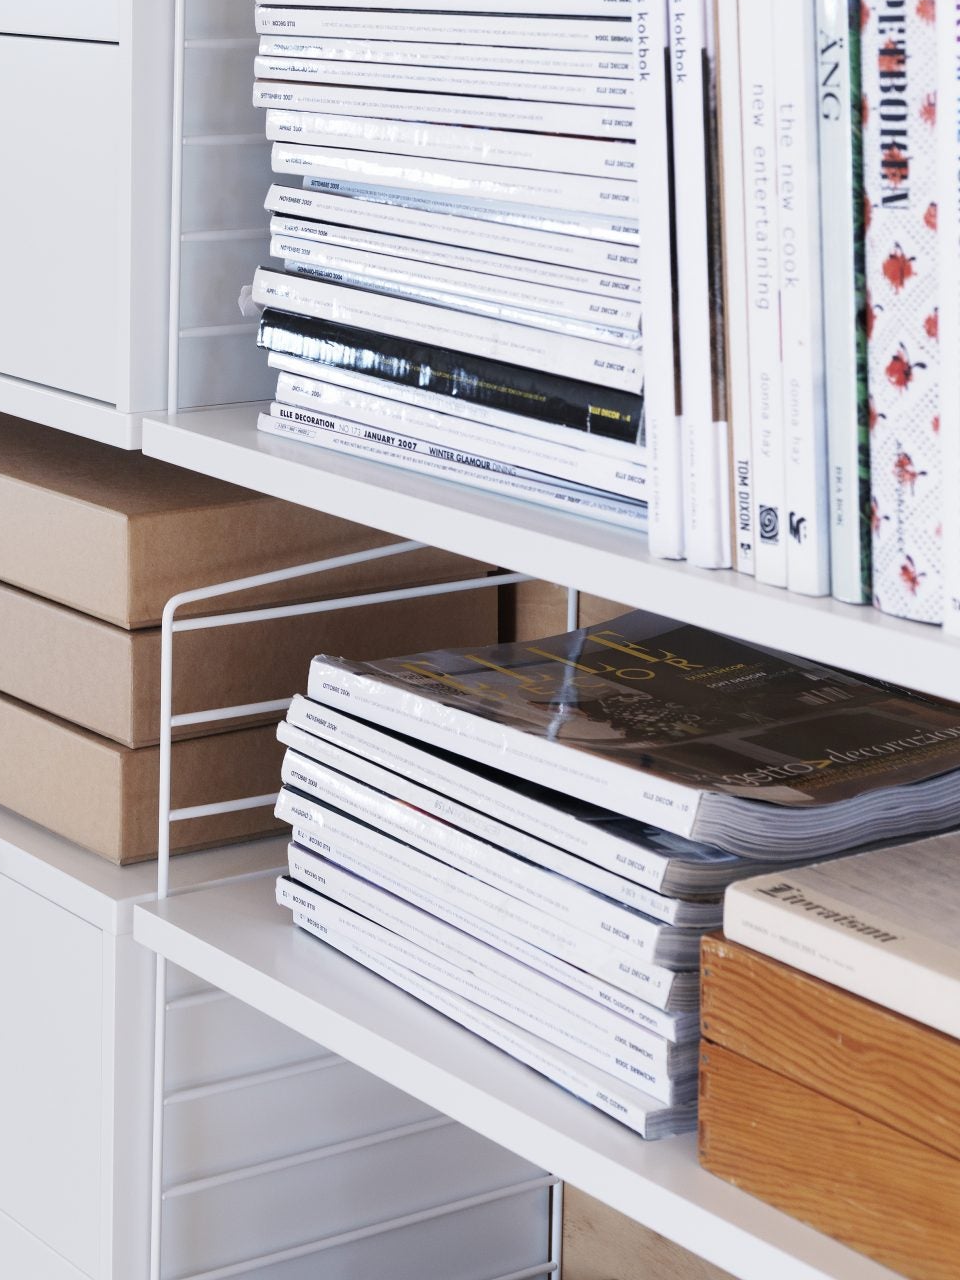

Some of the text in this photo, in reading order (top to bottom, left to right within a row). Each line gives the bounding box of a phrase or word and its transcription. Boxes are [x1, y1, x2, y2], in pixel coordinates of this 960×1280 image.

[637, 12, 650, 82] kokbok
[674, 12, 687, 84] kokbok
[820, 30, 843, 122] ÄNG
[279, 196, 301, 204] NOVEMBRE
[753, 84, 772, 310] new entertaining
[780, 103, 799, 288] the new cook
[280, 409, 292, 418] ELLE
[295, 412, 335, 429] DECORATION
[350, 427, 361, 436] 173
[364, 430, 395, 445] JANUARY
[398, 439, 417, 450] 2007
[429, 446, 455, 462] WINTER
[456, 453, 490, 469] GLAMOUR
[738, 460, 751, 531] TOM DIXON
[306, 713, 327, 727] NOVEMBRE
